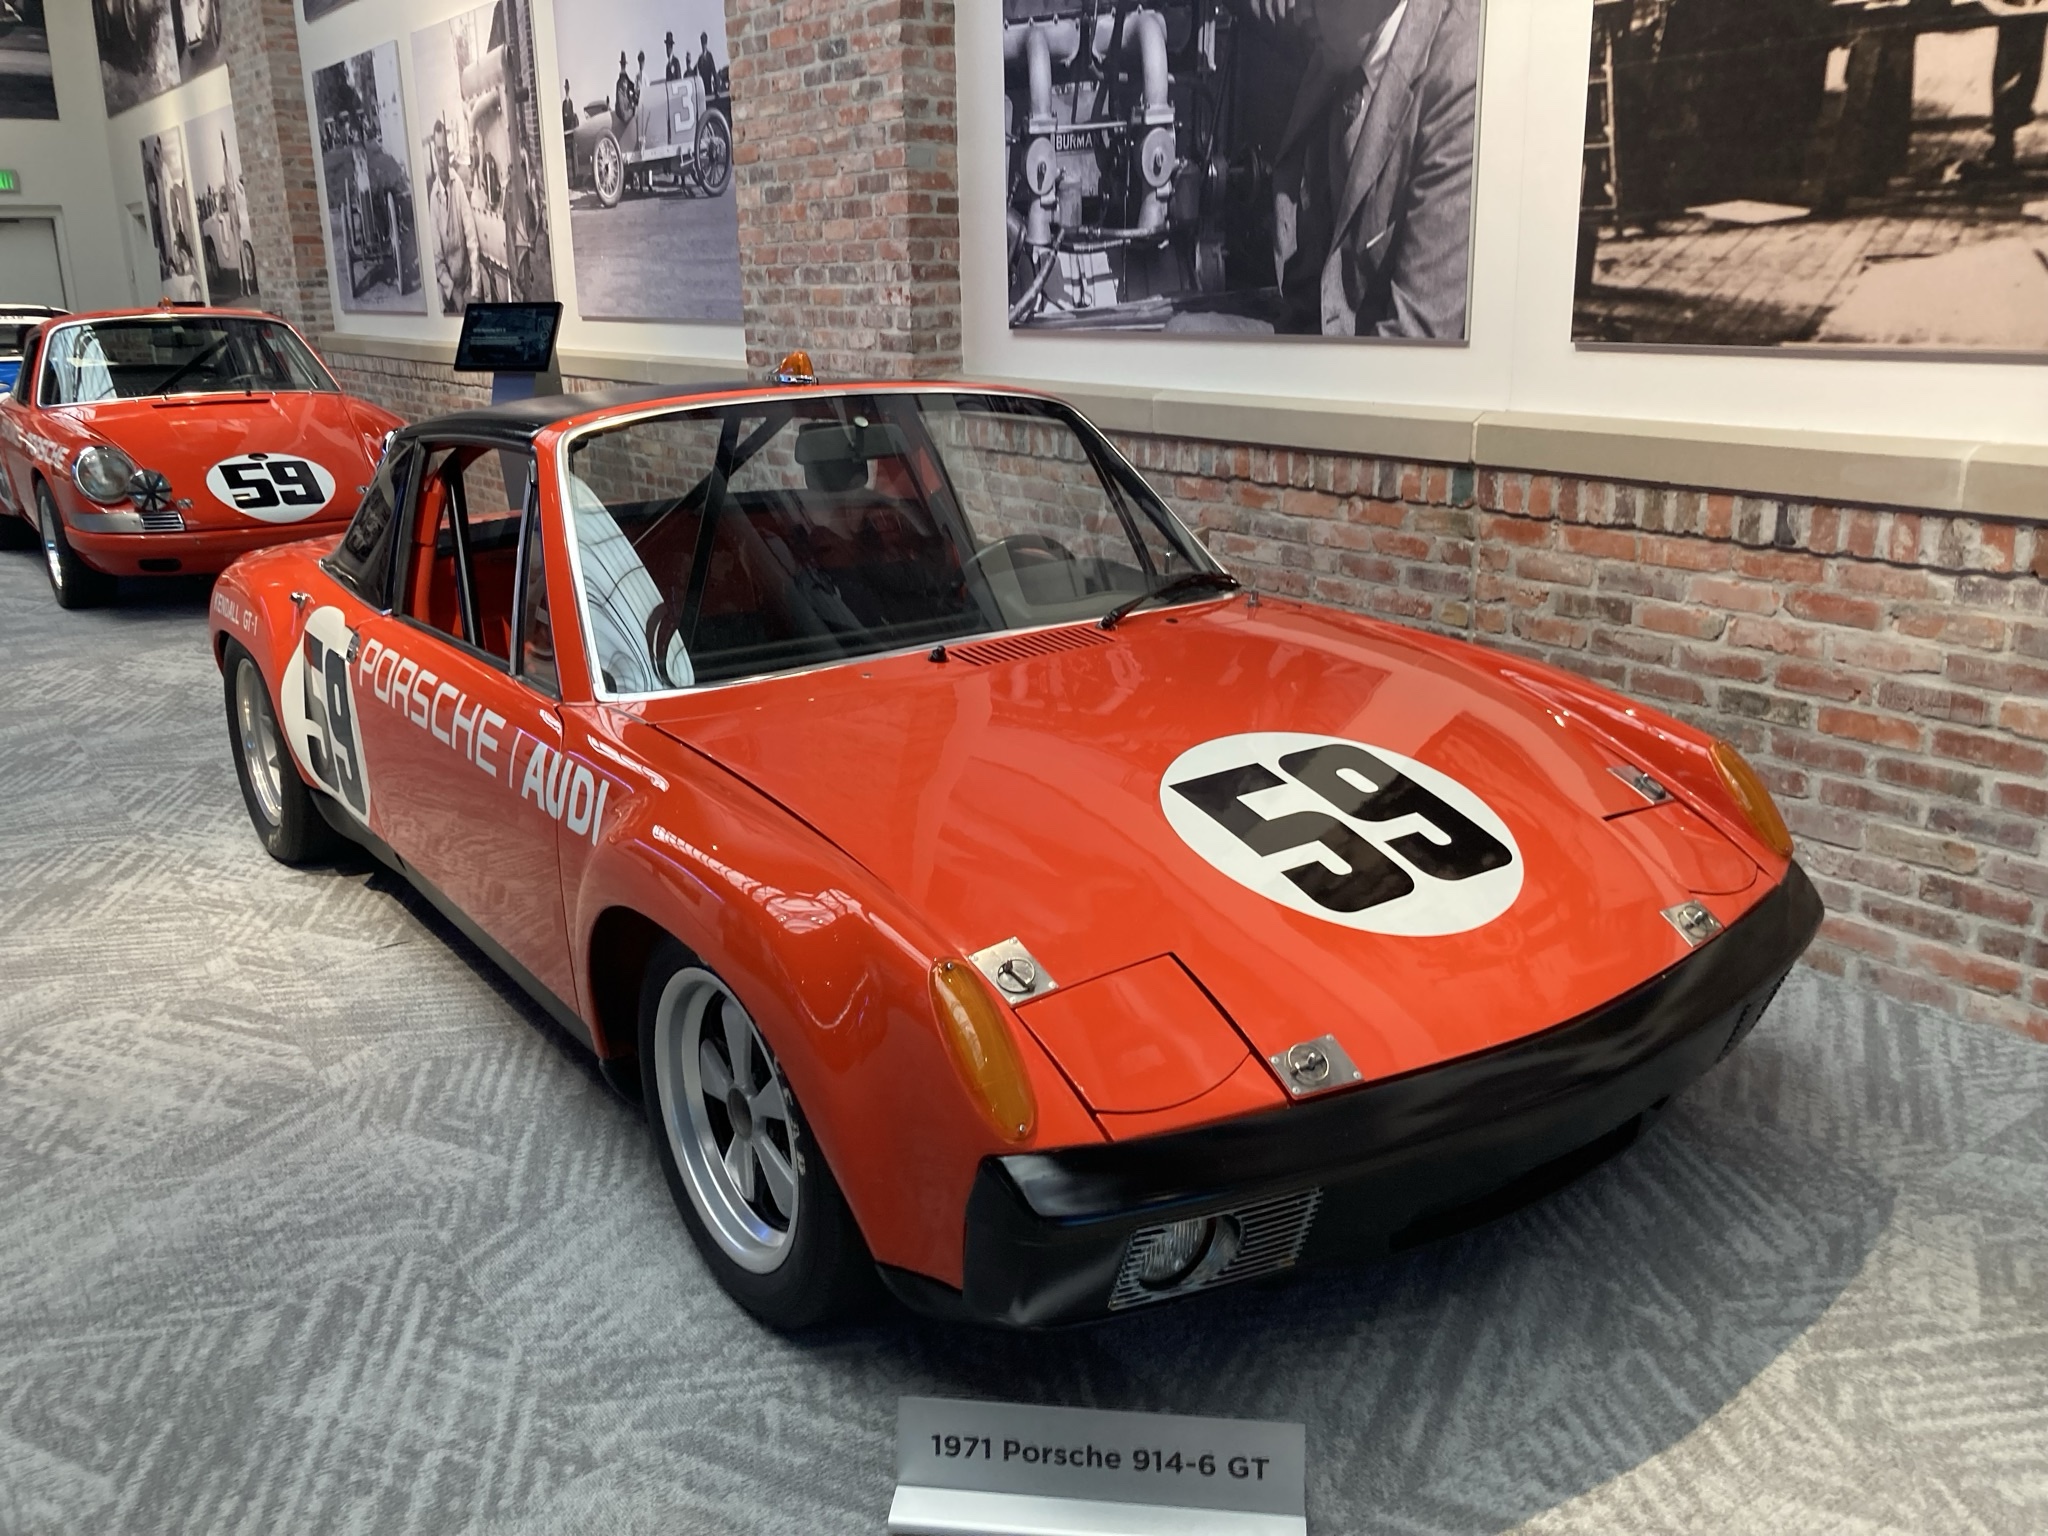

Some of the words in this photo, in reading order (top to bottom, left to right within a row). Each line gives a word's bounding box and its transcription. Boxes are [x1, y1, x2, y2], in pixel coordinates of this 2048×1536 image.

[671, 80, 696, 132] 3
[218, 461, 326, 509] 59
[214, 591, 239, 625] KENDALL
[304, 630, 367, 816] 59
[358, 637, 507, 777] PORSCHE
[521, 741, 610, 847] AUDI
[1168, 743, 1513, 913] 59
[931, 1433, 992, 1460] 1971
[1003, 1439, 1122, 1470] Porsche
[1132, 1449, 1216, 1478] 914-6
[1227, 1456, 1270, 1482] GT
